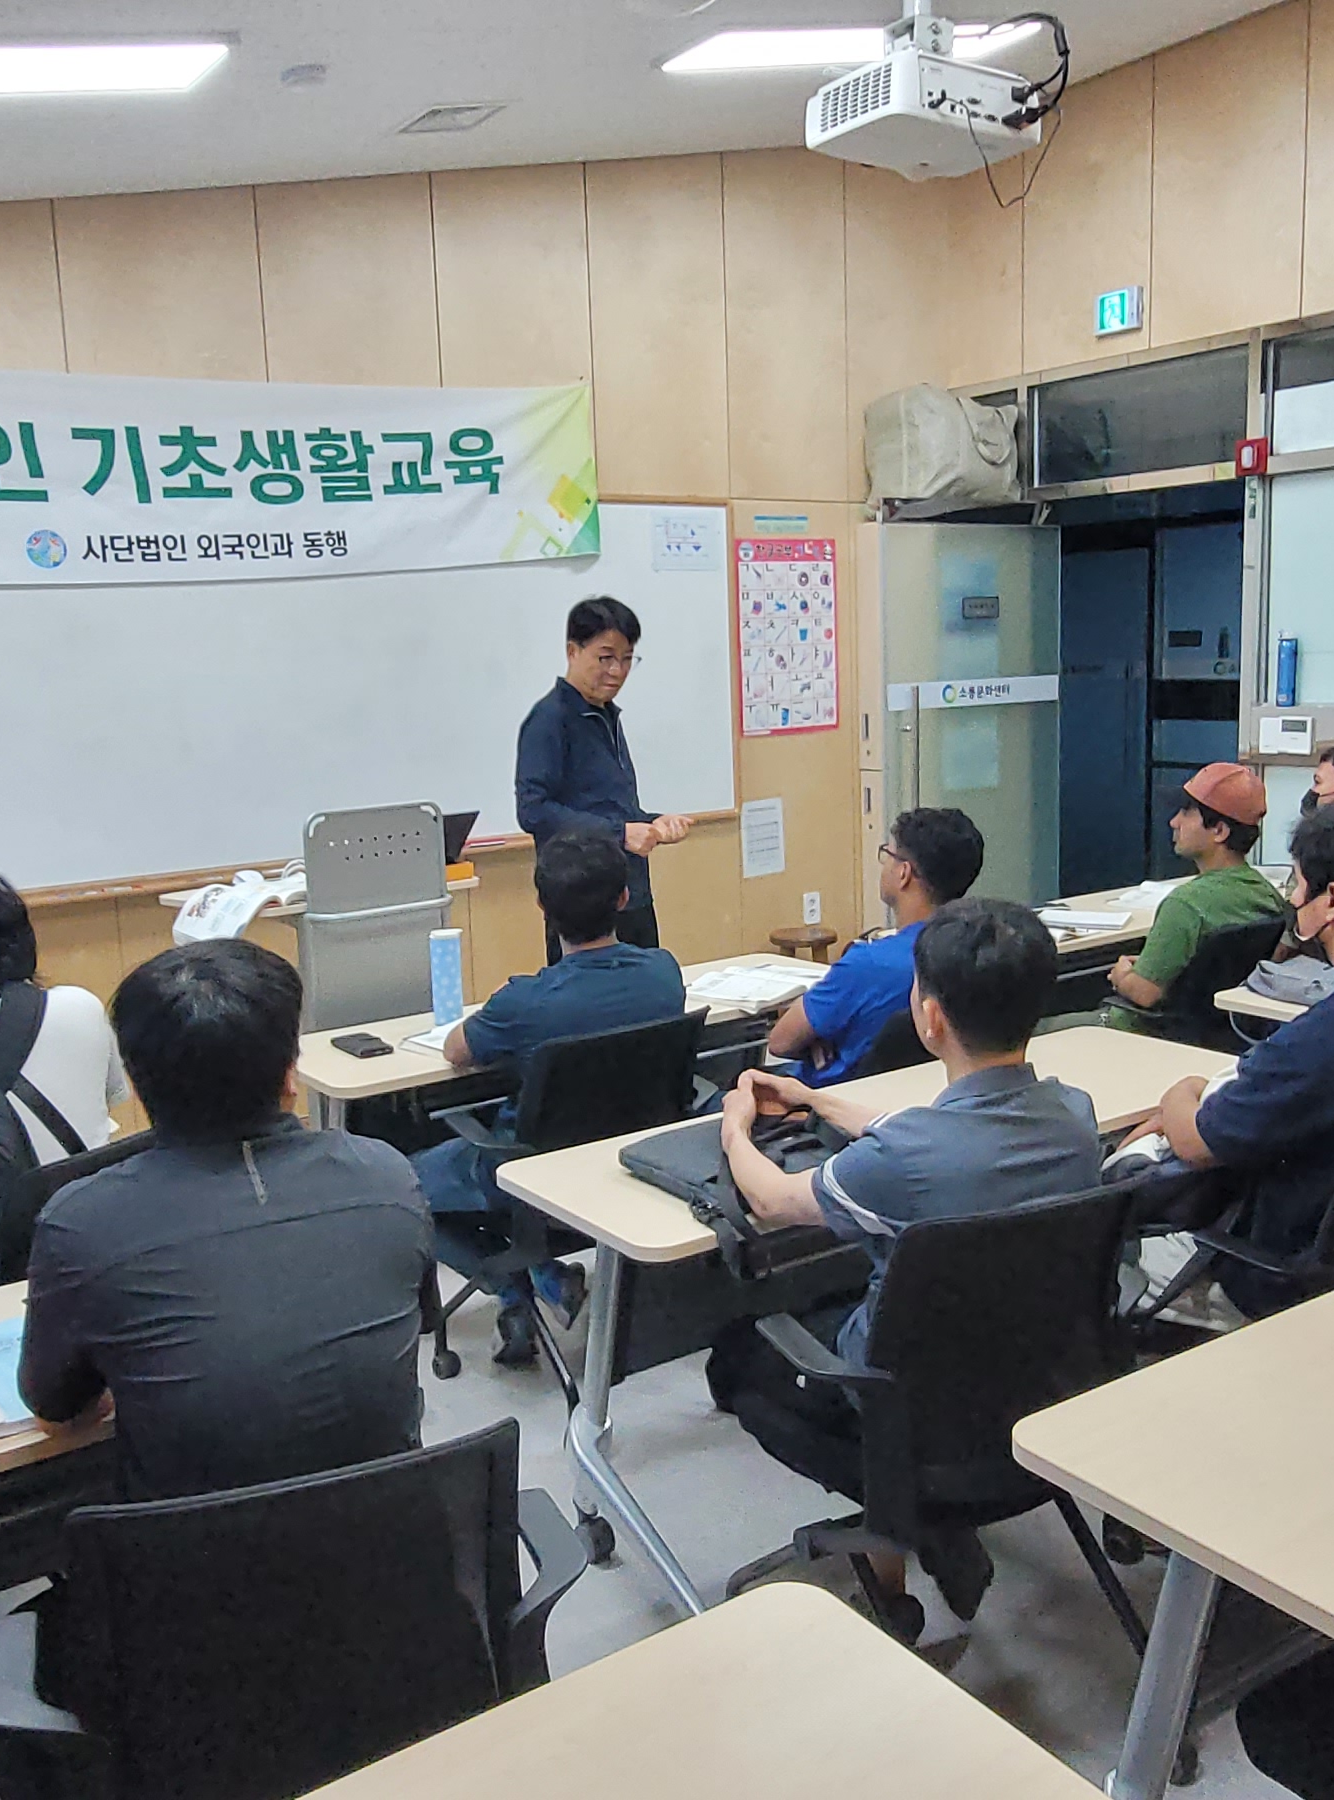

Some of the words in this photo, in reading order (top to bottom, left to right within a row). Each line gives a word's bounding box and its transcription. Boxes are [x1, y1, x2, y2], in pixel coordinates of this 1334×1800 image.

[71, 426, 504, 505] 기초생활교육
[82, 534, 187, 563] 사단법인
[196, 532, 294, 561] 외국인과
[303, 530, 348, 558] 동행
